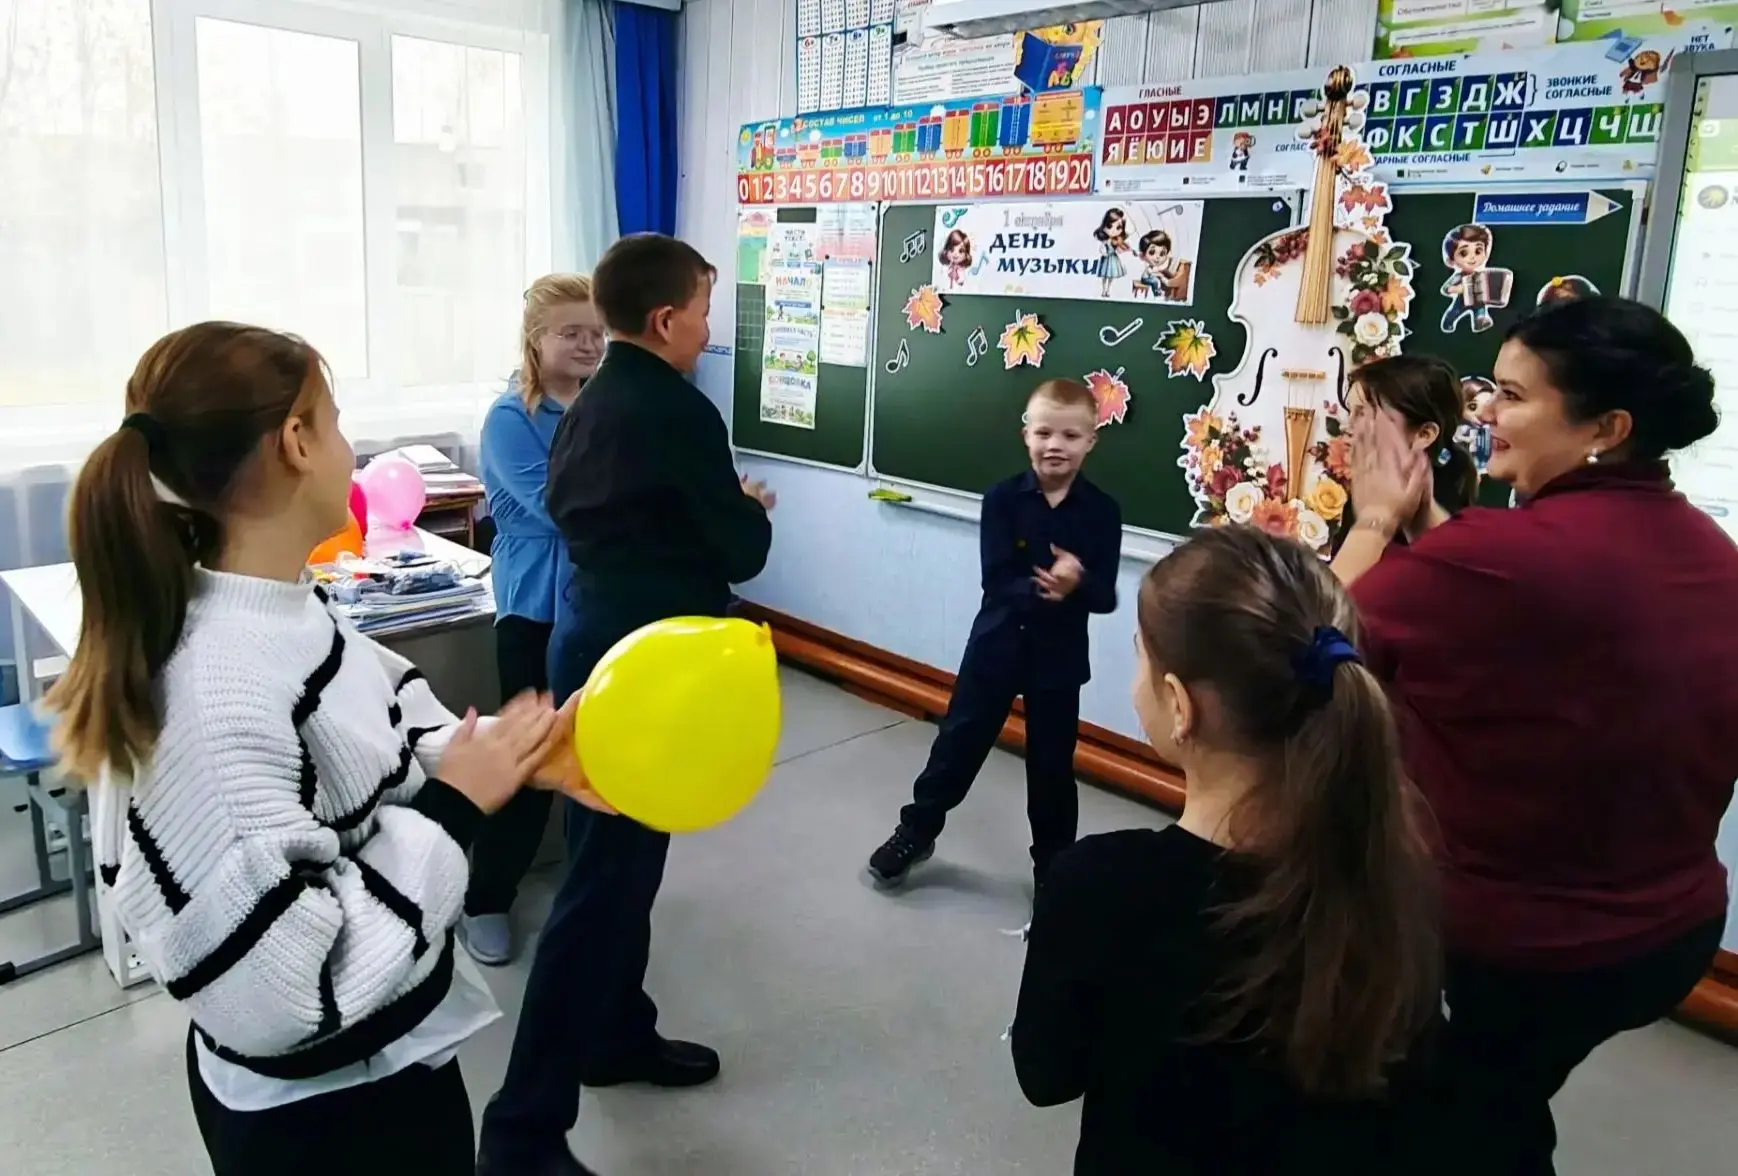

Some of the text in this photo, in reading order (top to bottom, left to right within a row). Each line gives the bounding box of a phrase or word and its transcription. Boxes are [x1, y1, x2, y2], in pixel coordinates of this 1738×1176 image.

[1691, 34, 1709, 43] НЕТ
[1379, 60, 1456, 76] СОГЛАСНЫЕ
[1548, 74, 1597, 88] ЗВОНКИЕ
[1139, 86, 1182, 98] ГЛАСНЫЕ
[1546, 86, 1612, 99] СОГЛАСНЫЕ
[804, 116, 834, 128] СОСТАВ
[837, 114, 864, 124] ЧИСЕЛ
[1276, 143, 1306, 152] СОГЛАС
[1412, 153, 1470, 163] СОГЛАСНЫЕ
[739, 178, 749, 200] 0
[752, 176, 760, 199] 1
[763, 176, 773, 199] 2
[776, 175, 787, 198] 3
[790, 174, 801, 198] 4
[805, 174, 816, 197] 5
[820, 173, 832, 197] 6
[836, 173, 848, 197] 7
[851, 172, 864, 196] 8
[868, 171, 880, 196] 9
[882, 170, 896, 196] 10
[900, 170, 914, 195] 11
[915, 168, 931, 194] 12
[932, 166, 948, 193] 13
[949, 165, 966, 193] 14
[967, 164, 984, 192] 15
[986, 164, 1004, 192] 16
[1006, 163, 1026, 191] 17
[1028, 162, 1045, 191] 18
[1048, 161, 1068, 190] 19
[1070, 160, 1090, 190] 20
[1483, 202, 1580, 216] Домашнее задание
[1004, 209, 1010, 227] 1
[989, 233, 1055, 254] ДЕНЬ
